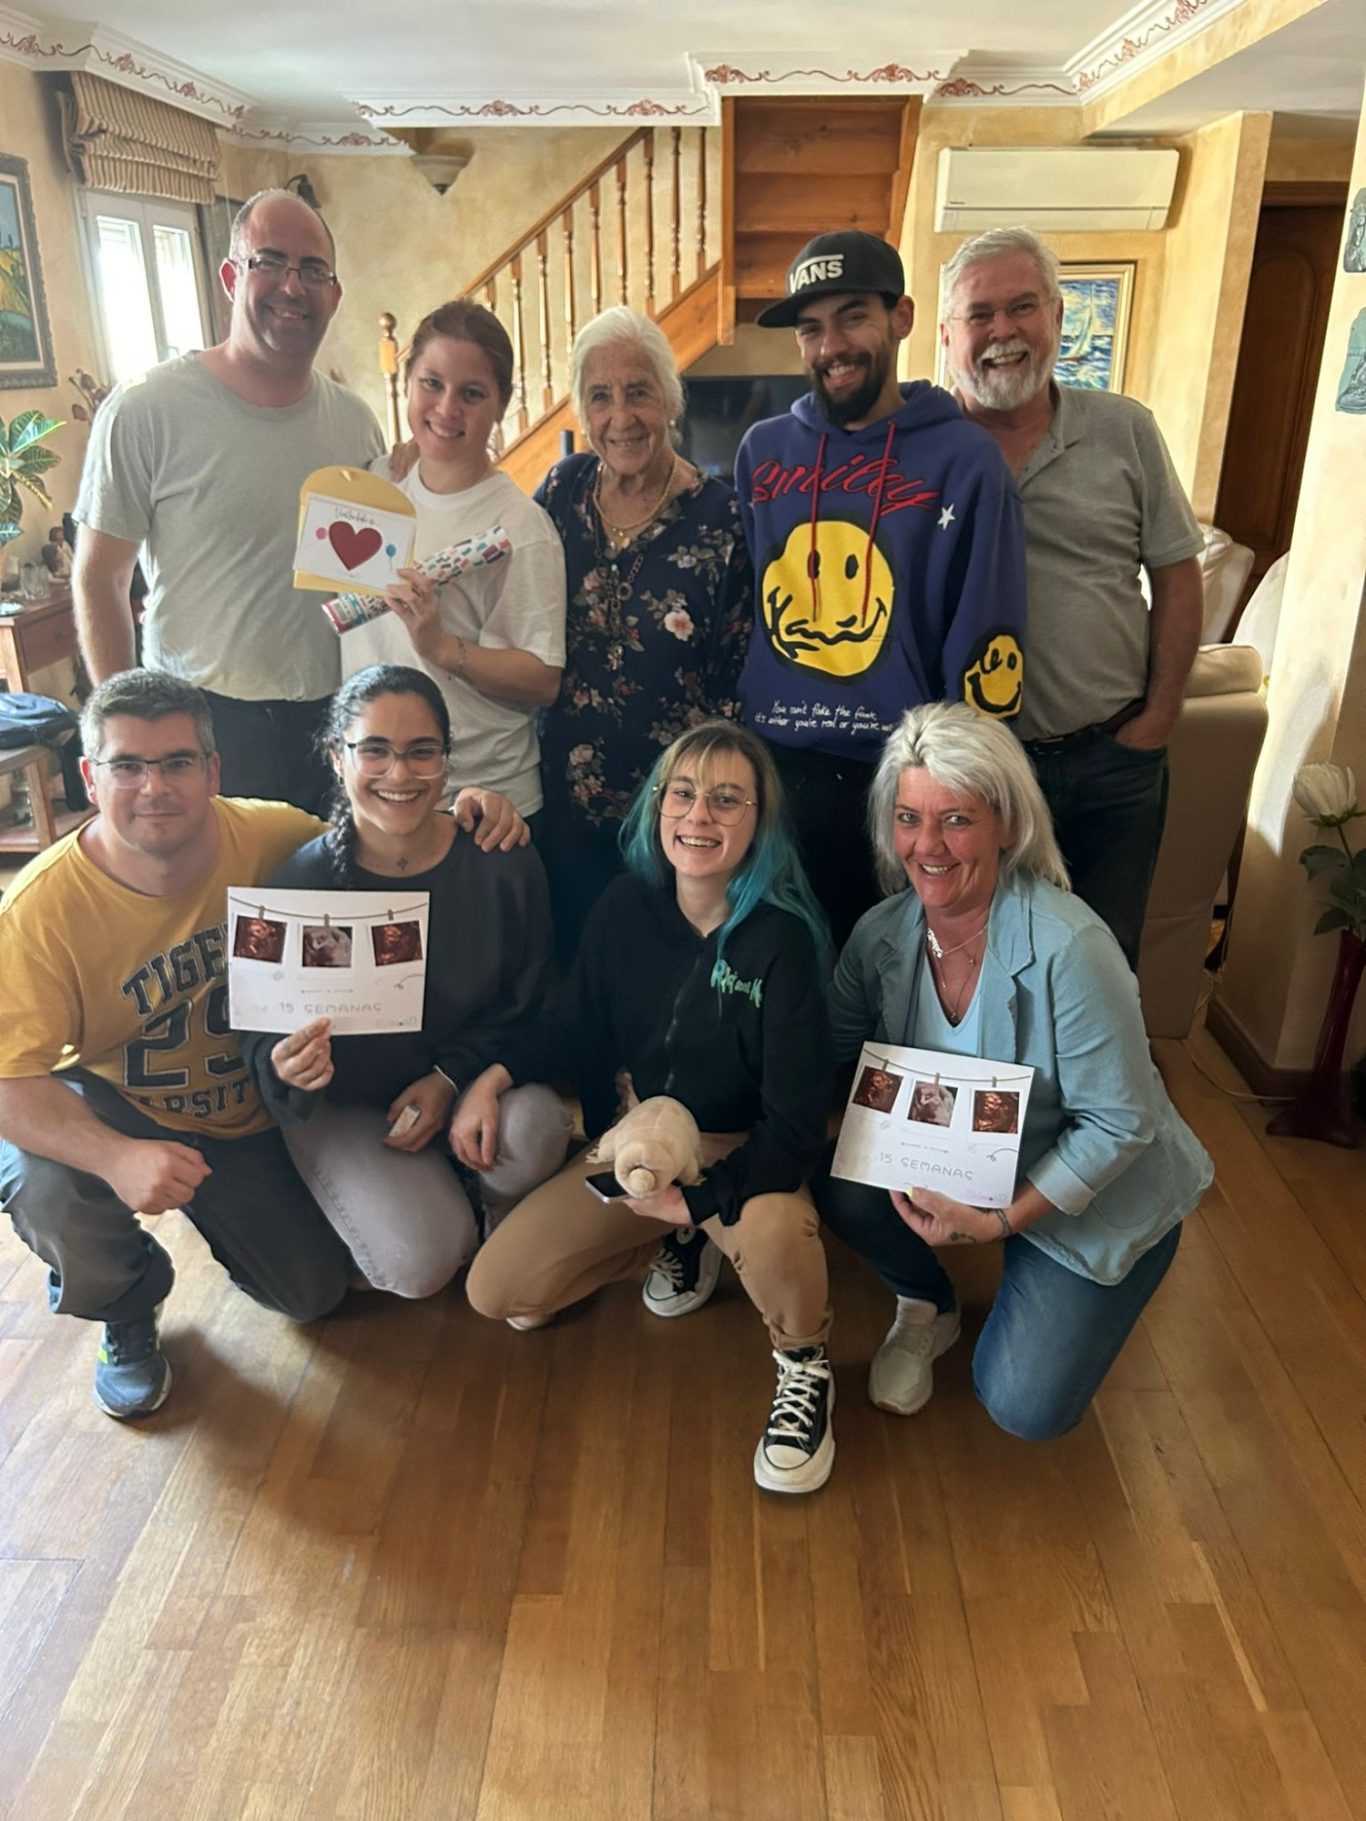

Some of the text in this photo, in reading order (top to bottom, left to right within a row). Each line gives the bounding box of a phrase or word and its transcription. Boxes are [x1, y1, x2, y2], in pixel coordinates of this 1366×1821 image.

[789, 254, 844, 294] VANS
[752, 455, 940, 517] Smiley
[812, 702, 831, 717] fake
[121, 922, 228, 1016] TIGE
[279, 1002, 294, 1013] 15
[139, 1077, 249, 1118] RSIT
[880, 1152, 975, 1182] 15 SEMANAS
